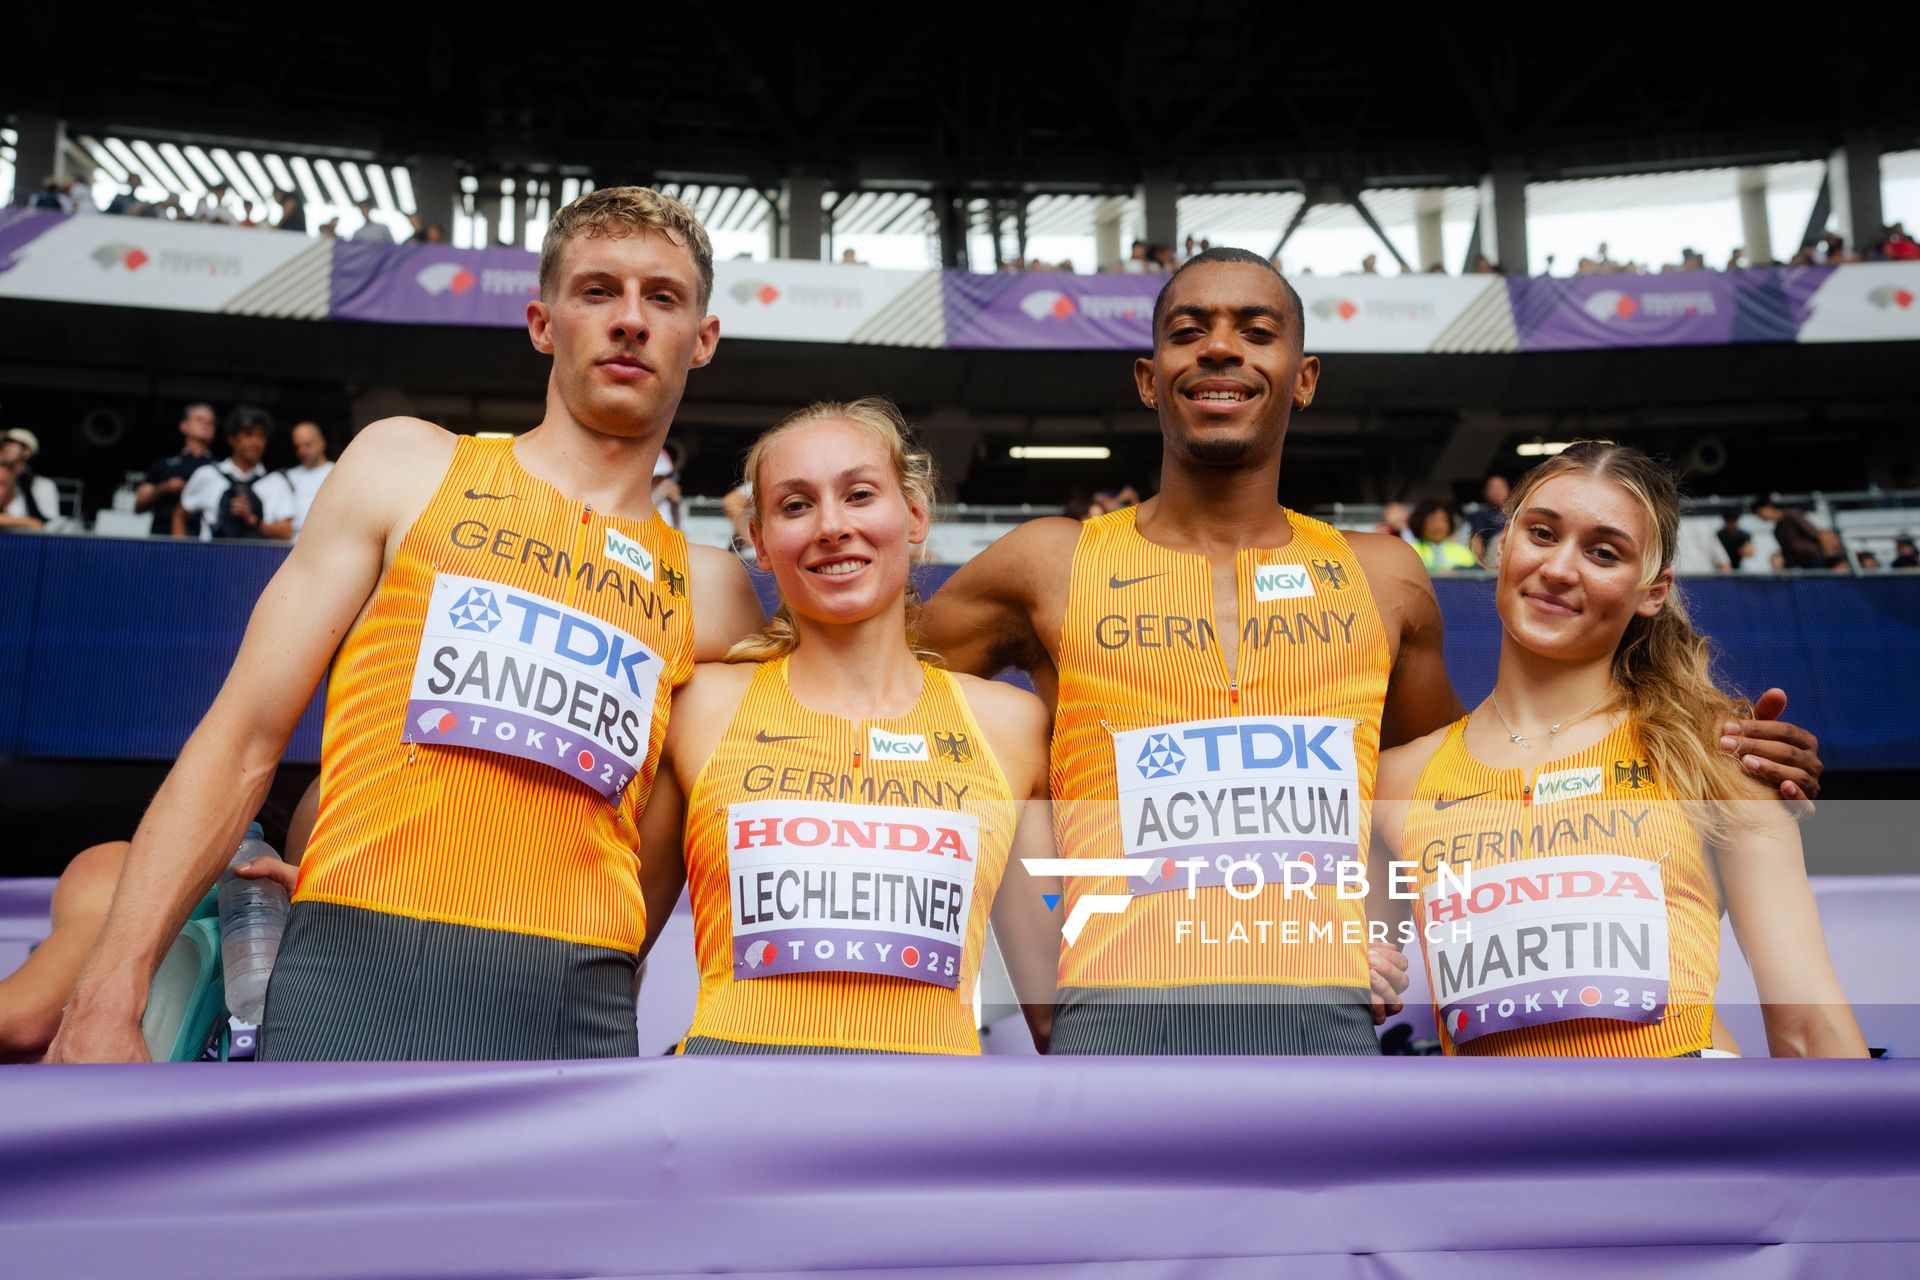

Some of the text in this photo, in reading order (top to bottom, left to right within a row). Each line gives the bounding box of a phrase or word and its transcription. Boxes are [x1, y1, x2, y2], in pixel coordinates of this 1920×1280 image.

[450, 520, 674, 632] GERMANY
[606, 534, 652, 572] WGV
[1255, 572, 1307, 592] WGV
[505, 594, 650, 700] TDK
[1095, 609, 1356, 651] GERMANY
[427, 645, 639, 757] SANDERS
[872, 736, 924, 754] WGV
[1183, 724, 1342, 772] TDK
[742, 765, 968, 810] GERMANY
[1537, 774, 1600, 797] WGV
[734, 817, 973, 862] HONDA
[1136, 786, 1350, 847] AGYEKUM
[1421, 808, 1650, 875] GERMANY
[738, 869, 964, 935] LECHLEITNER
[1428, 871, 1660, 930] HONDA
[1437, 922, 1651, 999] MARTIN
